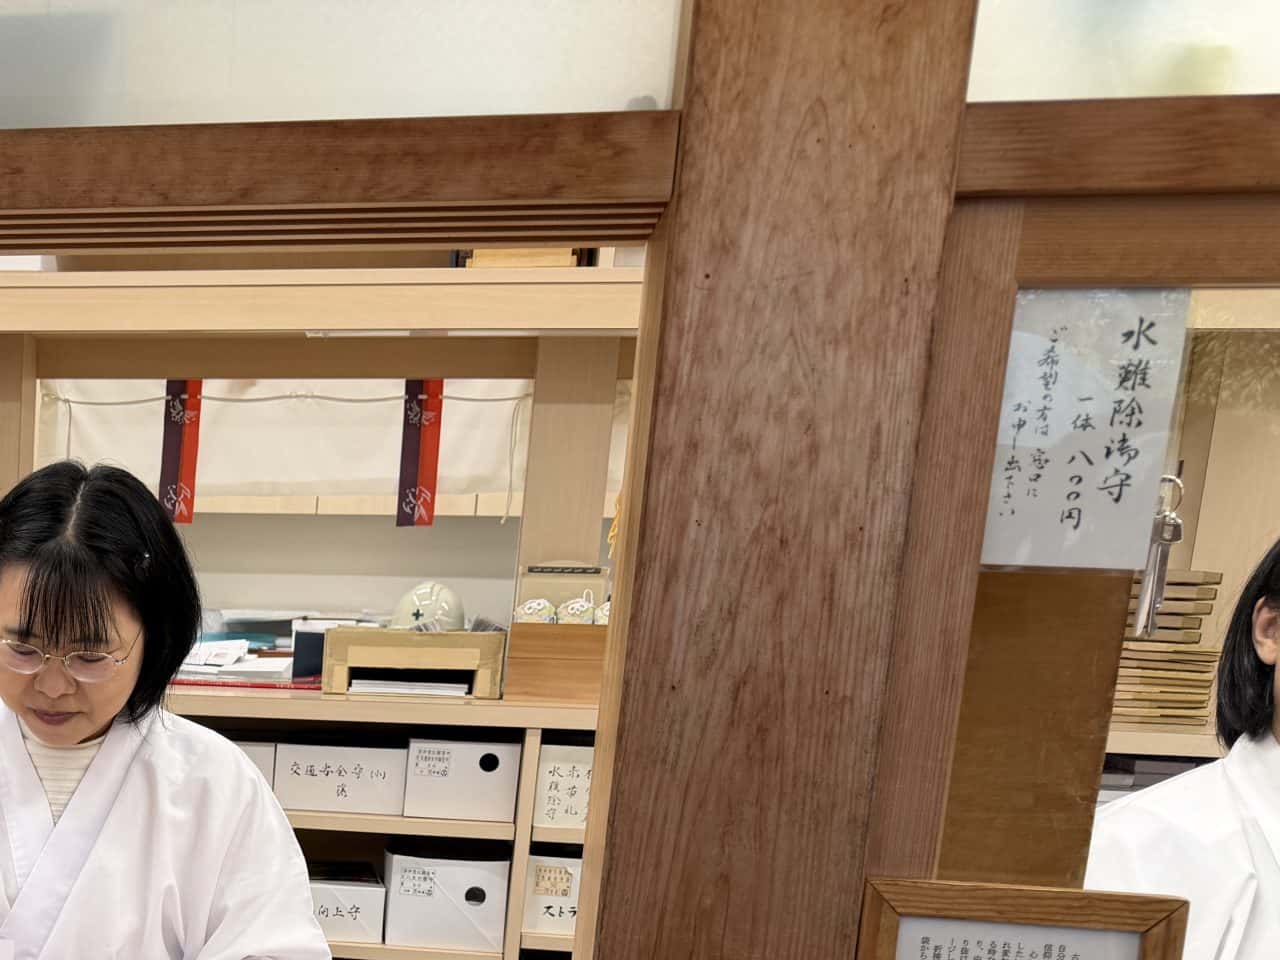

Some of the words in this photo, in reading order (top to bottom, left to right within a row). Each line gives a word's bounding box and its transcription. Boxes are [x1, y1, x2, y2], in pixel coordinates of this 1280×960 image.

[1096, 316, 1158, 504] 水難除御守
